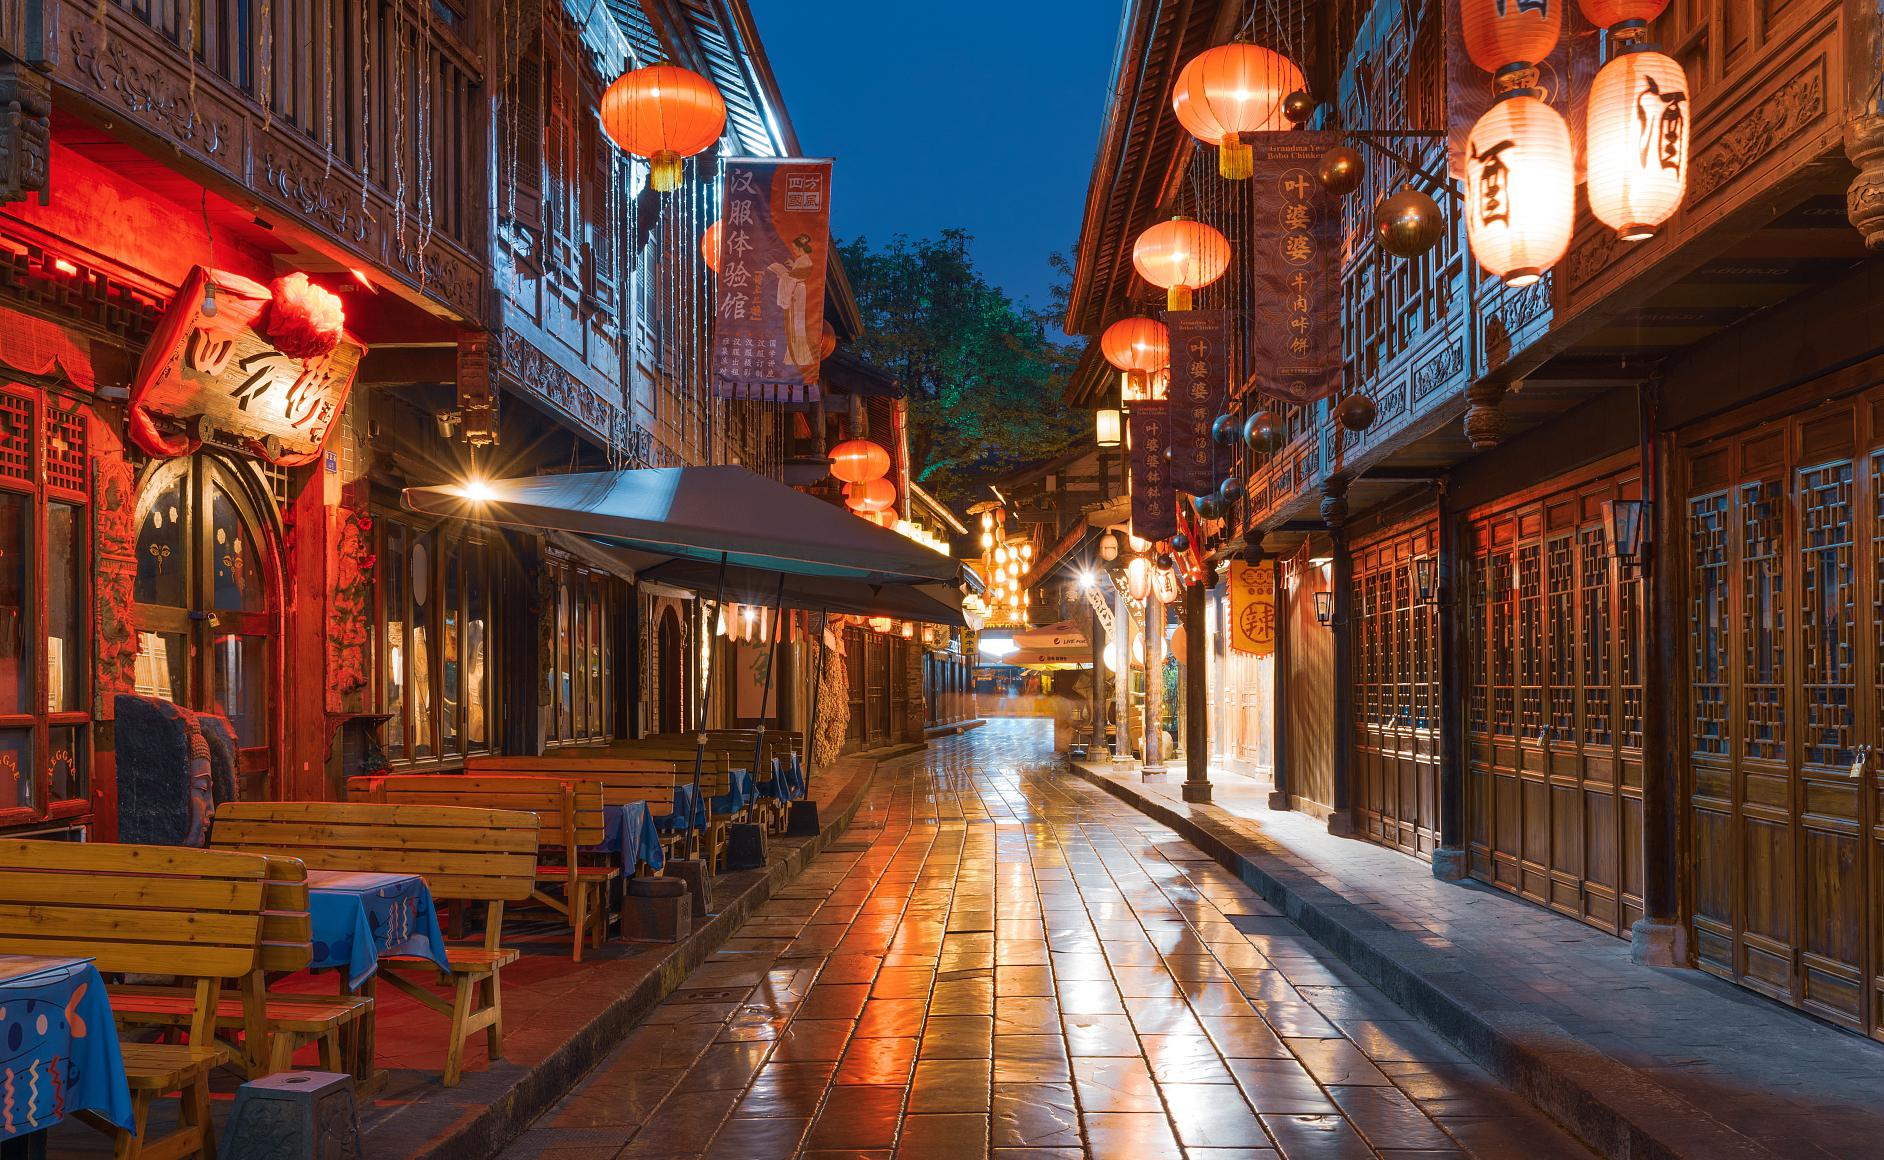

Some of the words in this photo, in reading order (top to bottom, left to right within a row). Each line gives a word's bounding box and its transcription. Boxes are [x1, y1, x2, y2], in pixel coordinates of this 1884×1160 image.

[1636, 75, 1686, 182] 酒
[789, 176, 820, 190] 四方
[1284, 174, 1312, 261] 叶婆婆
[720, 168, 757, 320] 汉服体验馆
[1190, 340, 1209, 400] 叶婆婆
